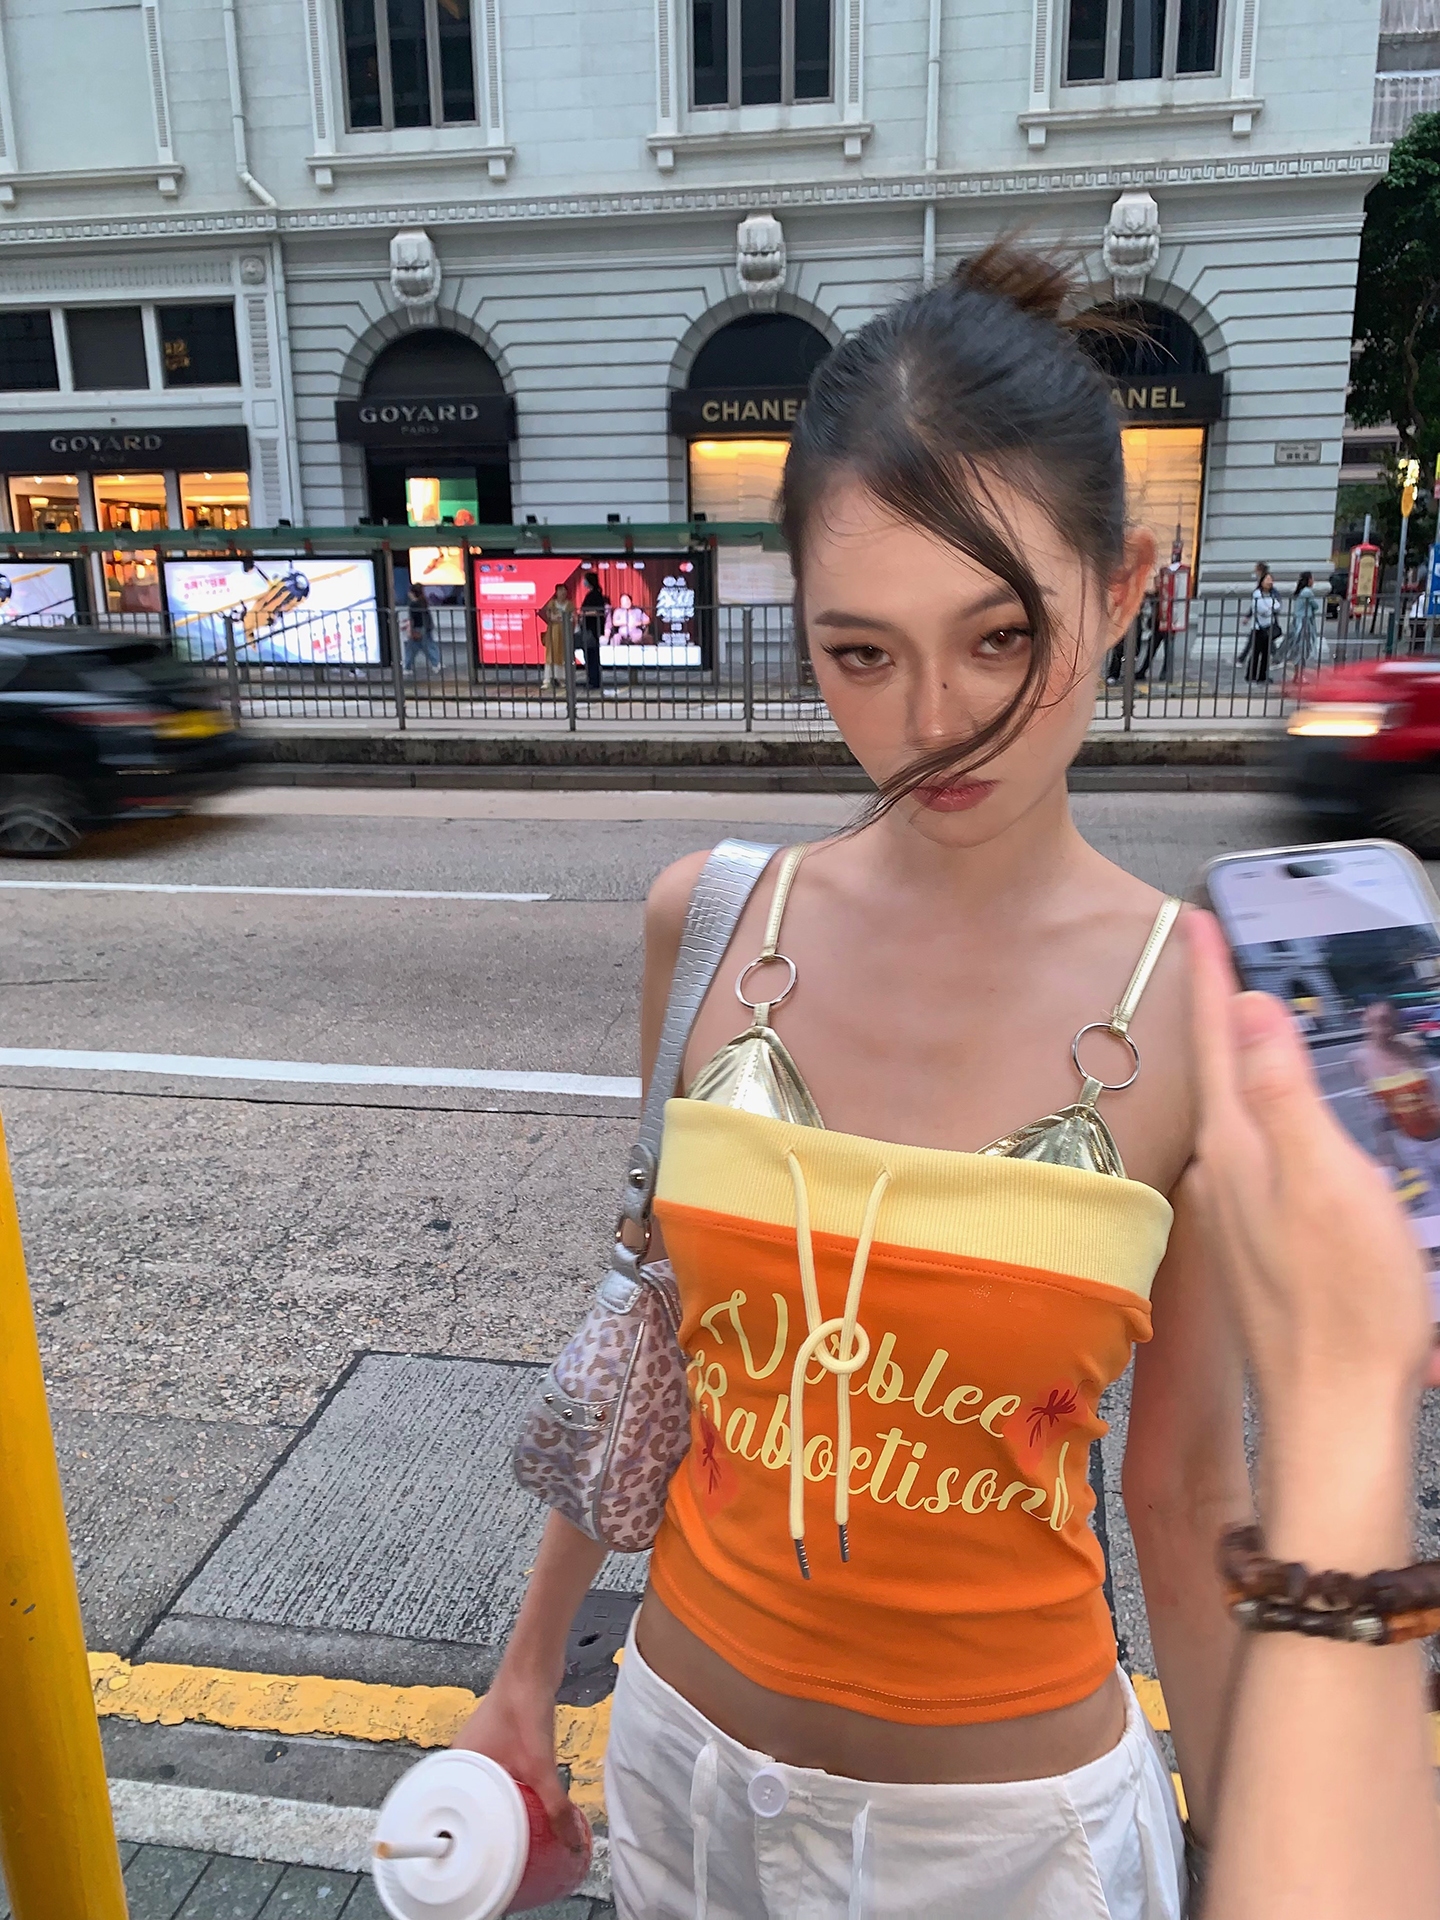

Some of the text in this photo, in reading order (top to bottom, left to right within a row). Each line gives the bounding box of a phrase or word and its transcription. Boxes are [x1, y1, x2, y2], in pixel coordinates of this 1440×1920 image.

[1109, 386, 1186, 409] ANEL
[358, 402, 480, 424] GOYARD
[49, 434, 162, 453] GOYARD
